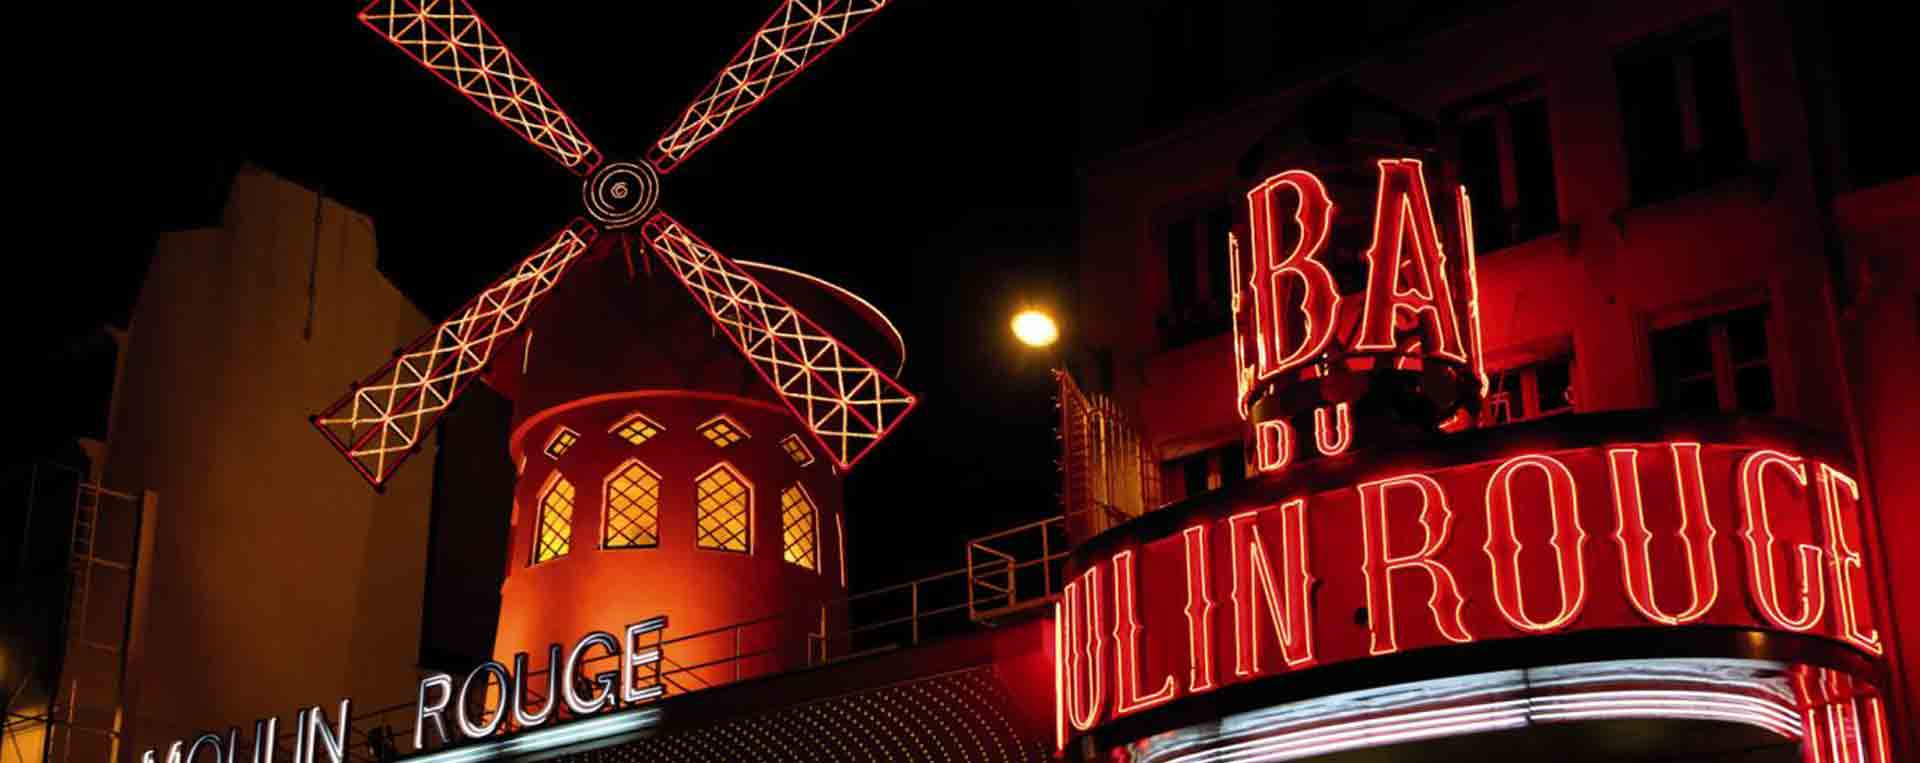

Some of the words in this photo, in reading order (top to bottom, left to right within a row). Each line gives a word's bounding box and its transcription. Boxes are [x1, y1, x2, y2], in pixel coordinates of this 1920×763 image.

[1247, 157, 1489, 398] BA
[1255, 402, 1351, 471] DU
[413, 615, 669, 750] ROUGE
[1055, 499, 1313, 752] ULIN
[1357, 442, 1883, 656] ROUGE
